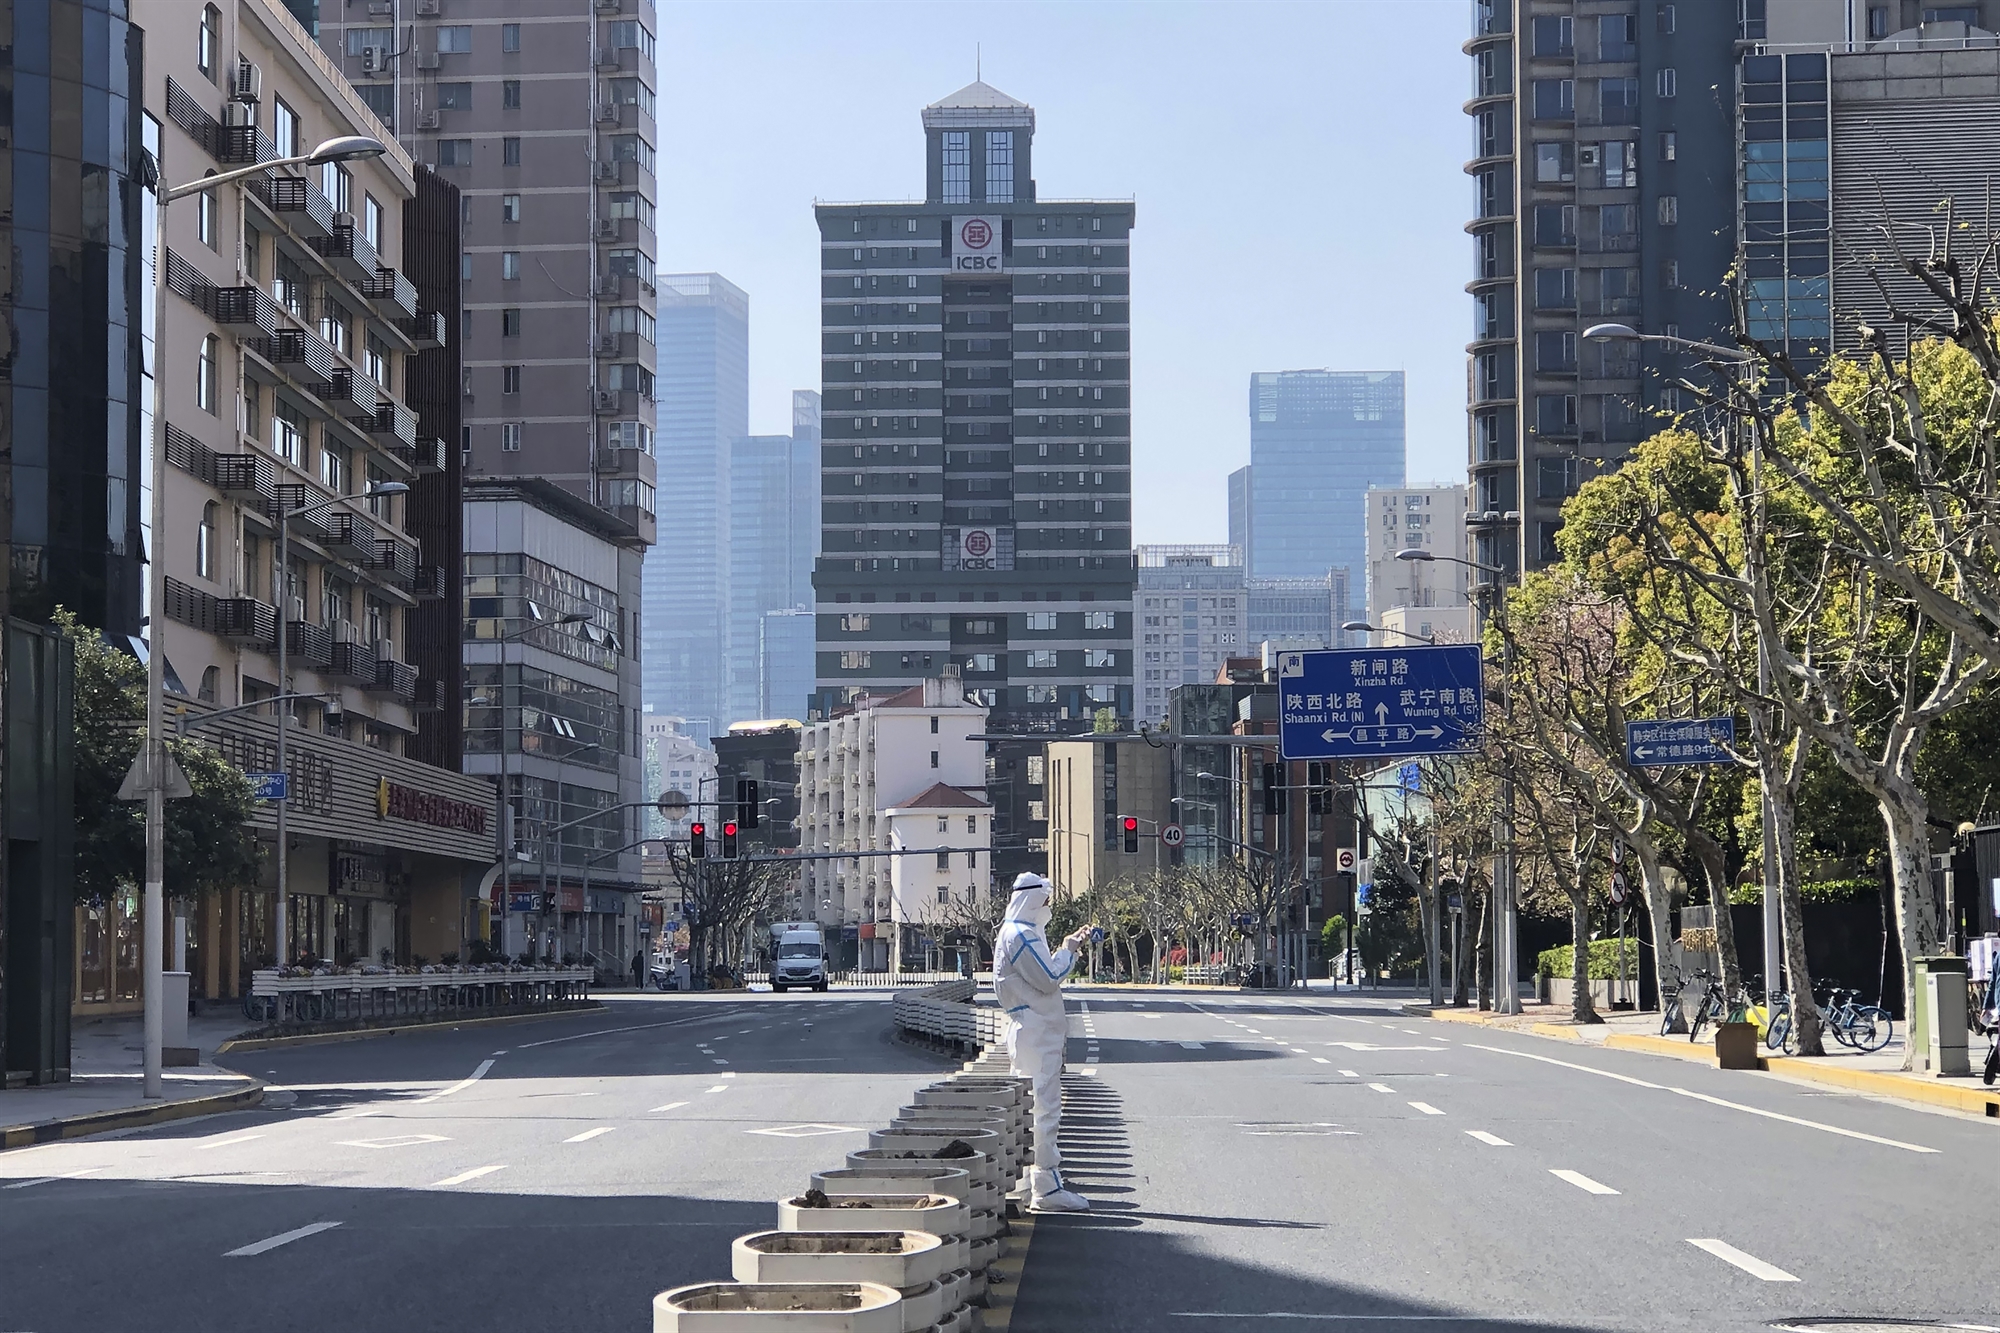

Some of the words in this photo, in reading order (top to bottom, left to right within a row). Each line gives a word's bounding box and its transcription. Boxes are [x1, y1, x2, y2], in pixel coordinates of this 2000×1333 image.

[957, 256, 997, 270] ICBC
[962, 558, 995, 570] ICBC
[1288, 655, 1300, 667] 南
[1350, 658, 1409, 676] 新闸路
[1354, 677, 1387, 687] Xinzha
[1390, 676, 1407, 686] Rd.
[1286, 692, 1363, 711] 陕西北路
[1399, 687, 1476, 706] 武宁南路
[1285, 711, 1327, 724] Shaanxi
[1332, 711, 1349, 723] Rd.
[1351, 711, 1365, 723] (N)
[1403, 707, 1439, 718] Wuning
[1444, 706, 1460, 716] Rd.
[1463, 704, 1475, 716] (S)
[1356, 727, 1410, 741] 昌平路
[1166, 829, 1180, 841] 40
